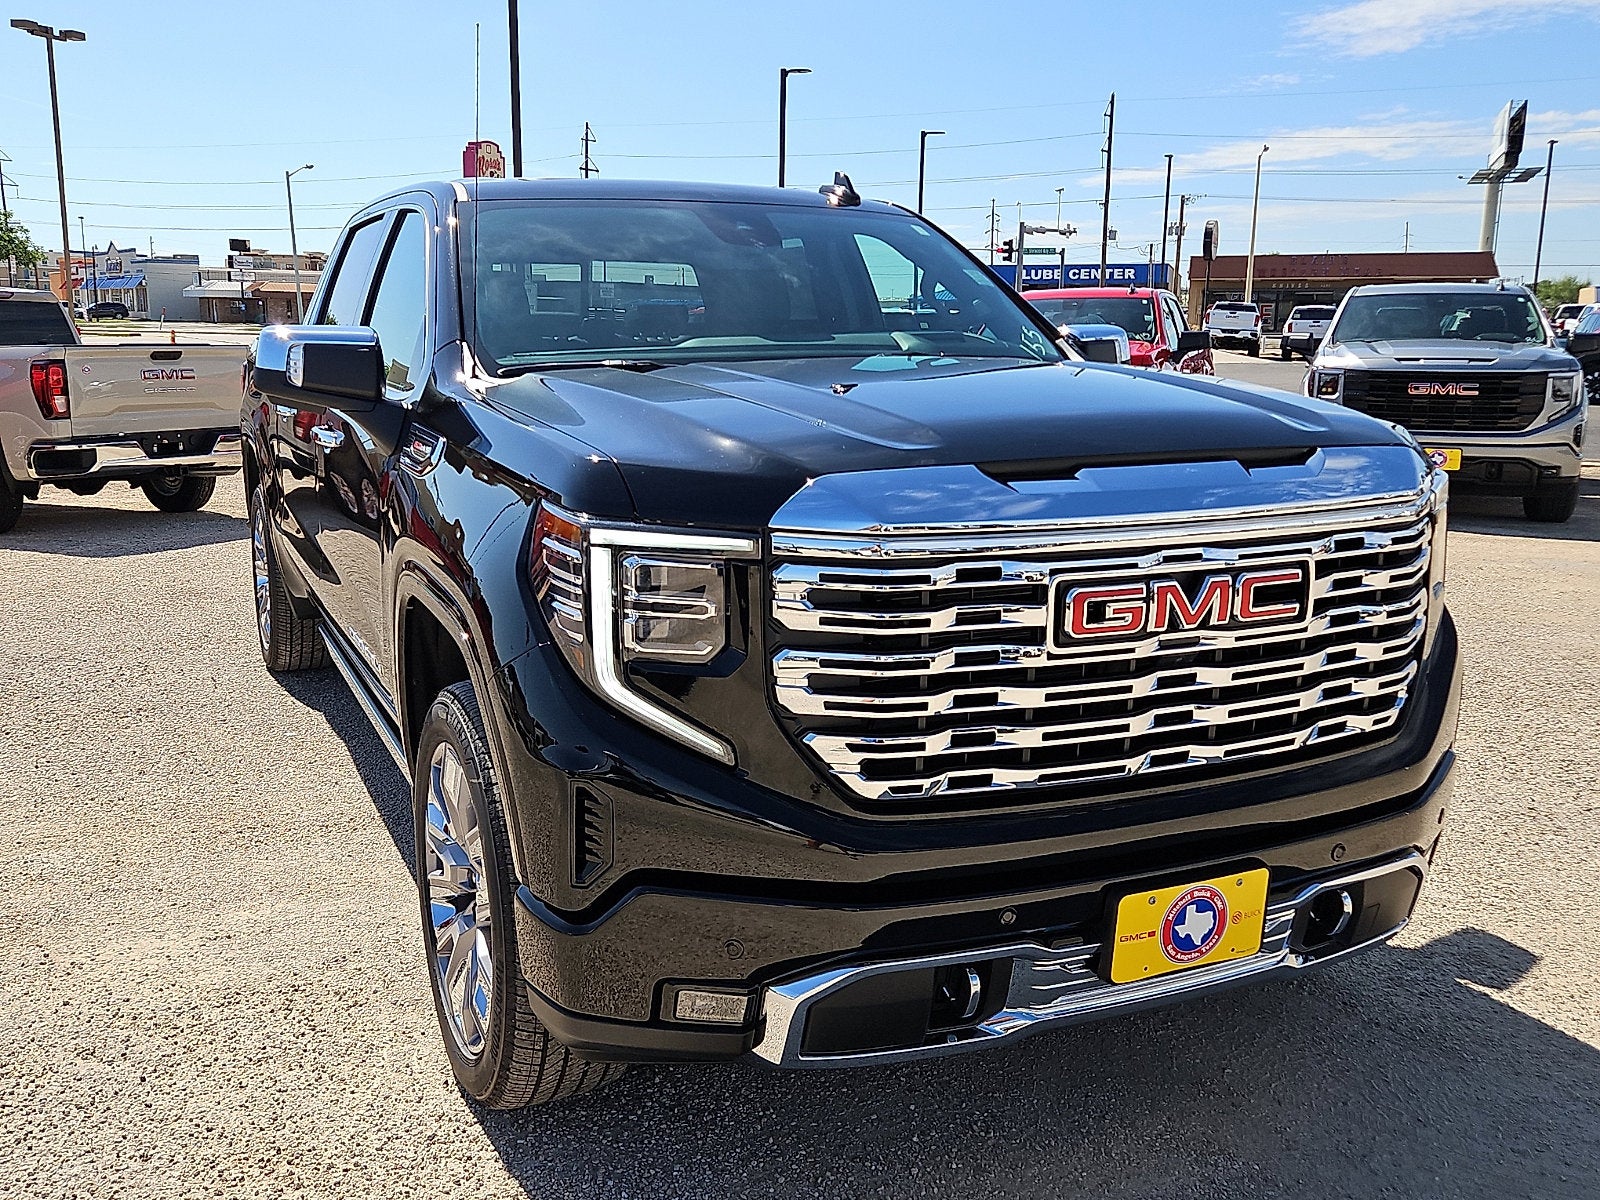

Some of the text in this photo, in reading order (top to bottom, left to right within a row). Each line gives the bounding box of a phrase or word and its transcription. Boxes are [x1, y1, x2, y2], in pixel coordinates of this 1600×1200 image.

[1022, 268, 1135, 280] LUBE CENTER
[140, 368, 196, 380] GMC
[1408, 382, 1480, 395] GMC
[1066, 571, 1301, 639] GMC
[1167, 893, 1191, 920] Mitchell
[1119, 931, 1148, 943] GMC
